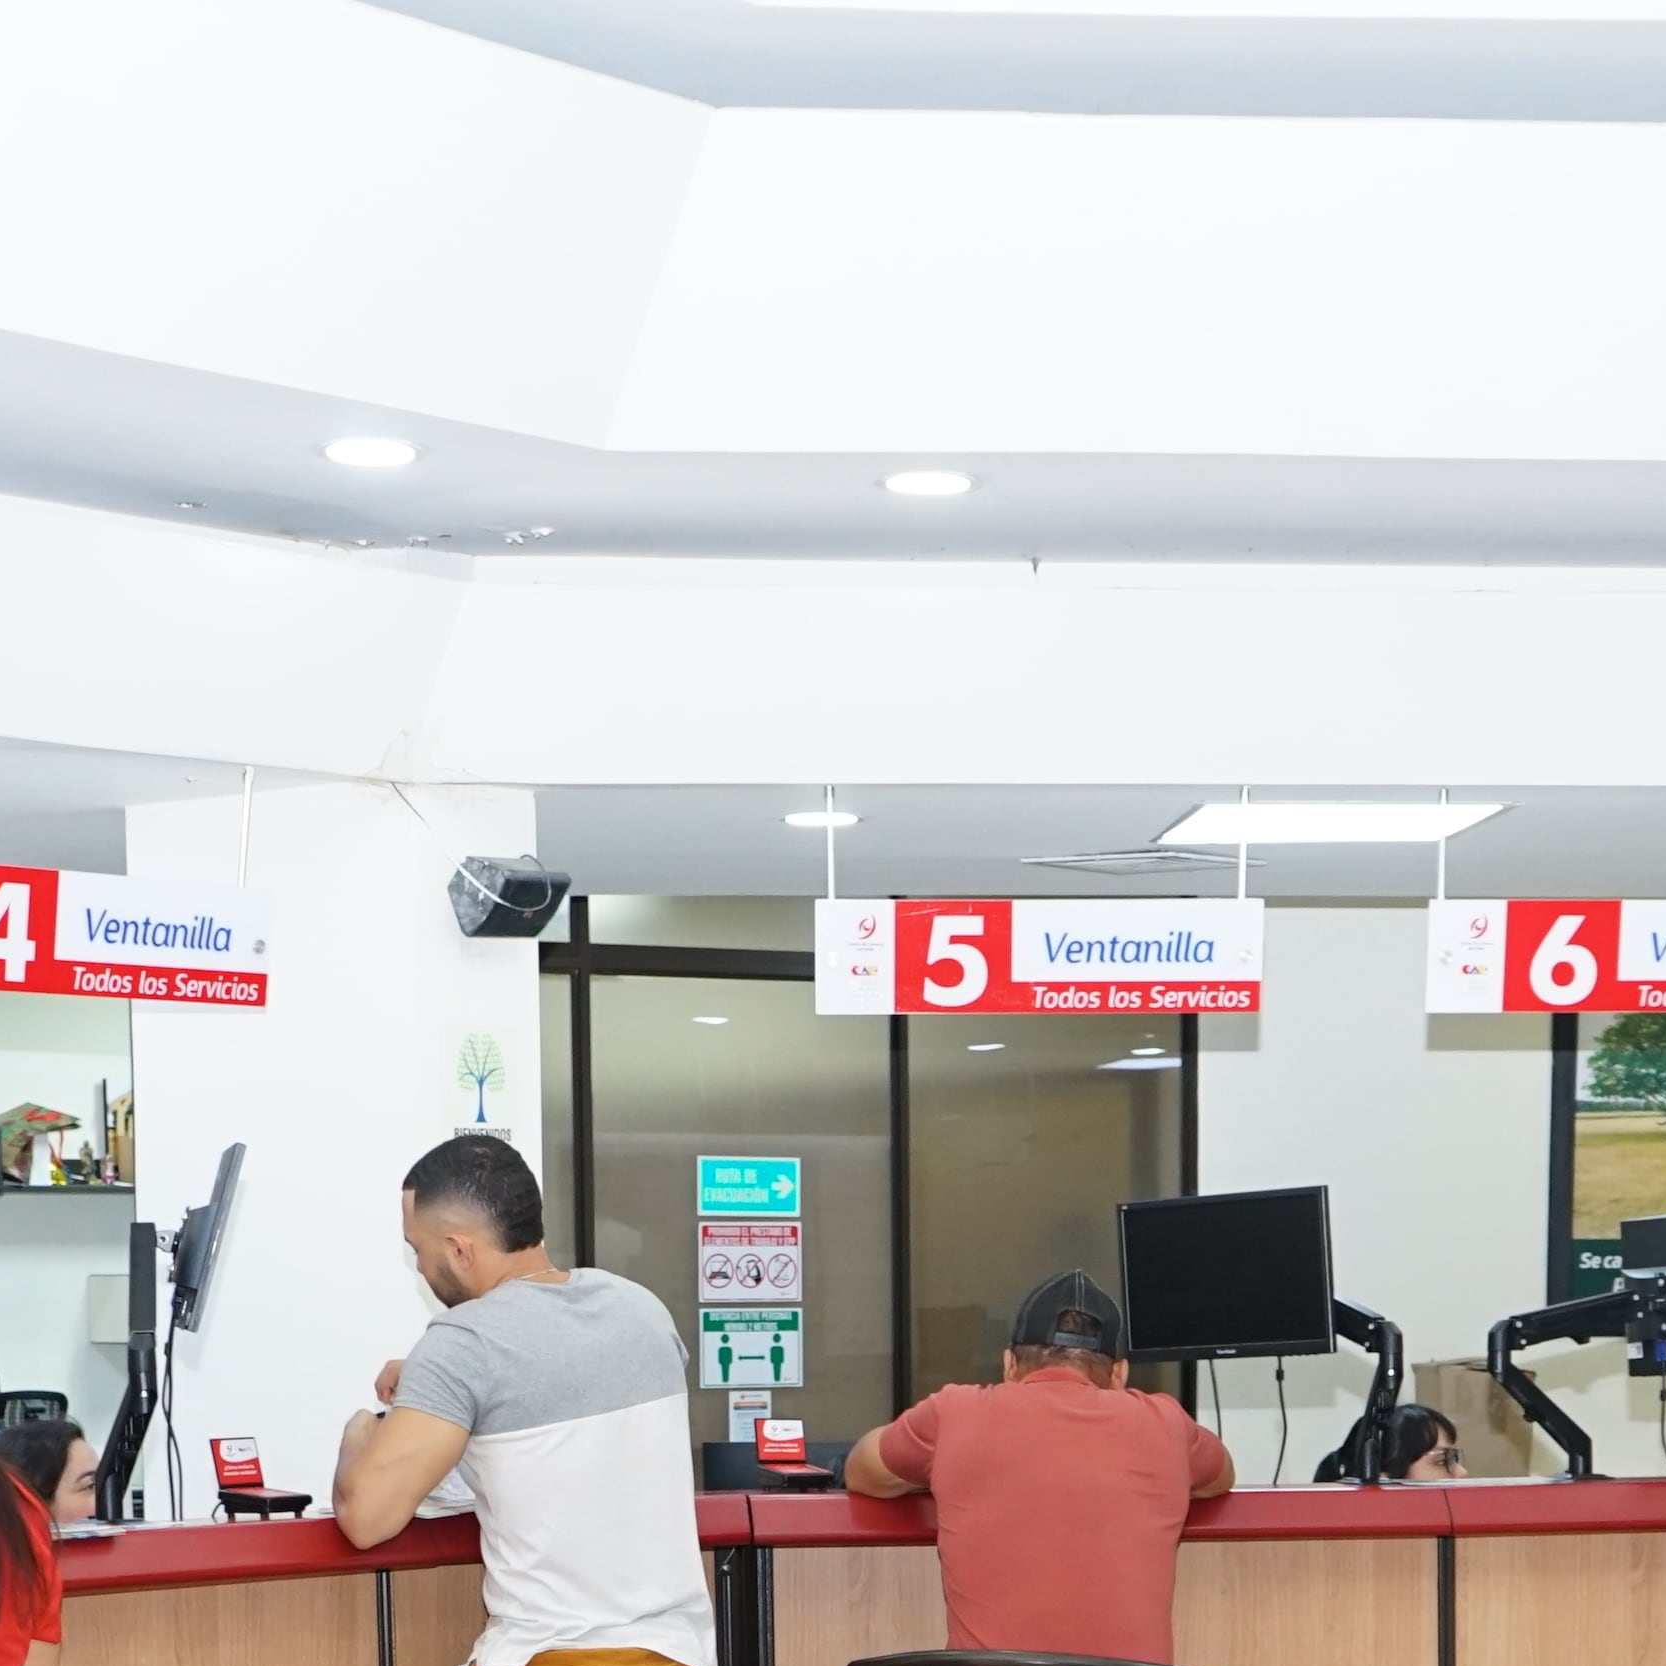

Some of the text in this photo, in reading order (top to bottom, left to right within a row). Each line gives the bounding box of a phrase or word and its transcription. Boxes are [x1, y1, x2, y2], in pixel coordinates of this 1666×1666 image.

[85, 908, 232, 953] Ventanilla
[1044, 931, 1214, 964] Ventanilla
[922, 914, 989, 1008] 5
[1528, 914, 1598, 1006] 6
[73, 966, 259, 1002] Todos los Servicios
[1033, 984, 1251, 1009] Todos los Servicios
[1579, 1252, 1602, 1269] Se
